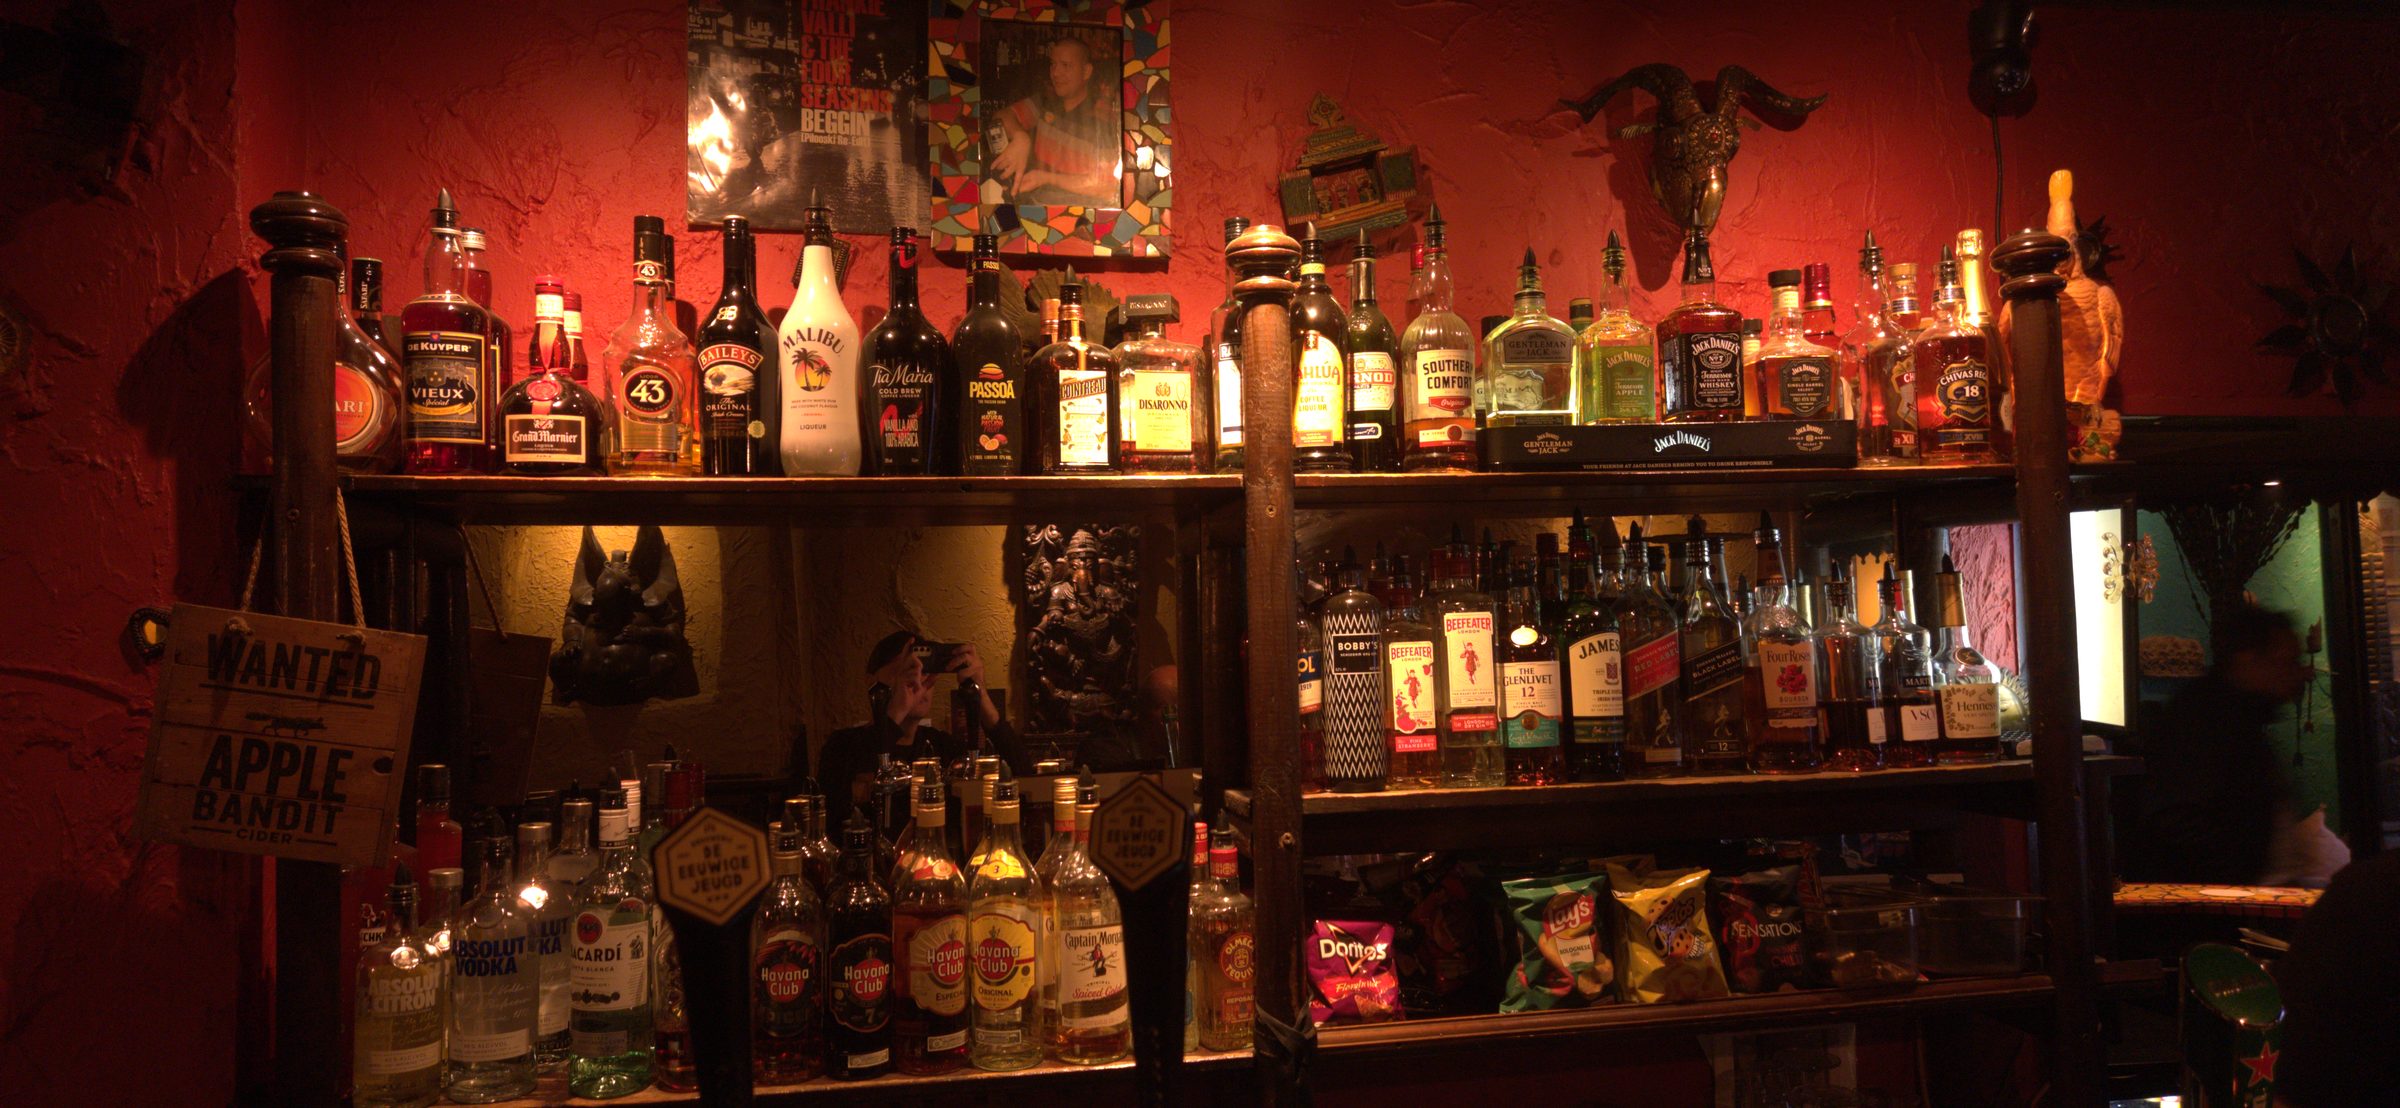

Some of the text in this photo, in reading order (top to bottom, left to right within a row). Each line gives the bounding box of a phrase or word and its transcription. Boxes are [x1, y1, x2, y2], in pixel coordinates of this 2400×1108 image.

[801, 10, 855, 37] VALLI
[801, 34, 854, 62] & THE
[801, 59, 853, 85] FOUR
[640, 265, 656, 277] 43
[407, 341, 469, 353] DE KUYPER
[783, 327, 845, 354] MALIBU
[1508, 340, 1567, 349] GENTLEMAN
[1691, 337, 1740, 356] JACK DANIEL'S
[701, 347, 757, 366] BAILEYS
[1605, 351, 1650, 369] JACK DANIEL'S
[867, 364, 934, 388] Tia Maria
[1297, 361, 1341, 386] AHLÚA
[1354, 372, 1393, 383] RNOD
[1701, 370, 1733, 379] Tennessee
[1791, 365, 1802, 375] JACK
[1940, 369, 1973, 386] CHIVAS
[1061, 378, 1107, 399] COINTREAU
[1427, 375, 1472, 390] COMFORT
[1616, 382, 1644, 390] Tennessee
[1963, 384, 1980, 397] 18
[412, 387, 465, 400] VIEUX
[630, 379, 666, 404] 43
[705, 404, 752, 412] ORIGINAL
[1139, 399, 1187, 410] DISARONNO
[1441, 397, 1465, 408] Original
[512, 430, 578, 443] Grand Marnier
[1523, 440, 1573, 448] GENTLEMAN
[1654, 430, 1712, 453] JACK DANIEL'S
[1537, 447, 1559, 455] JACK
[1446, 617, 1492, 632] BEEFEATER
[1337, 641, 1378, 651] BOBBY'S
[1391, 646, 1432, 660] BEEFEATER
[1579, 638, 1620, 659] JAMES
[1634, 647, 1679, 673] RED LABEL
[1767, 651, 1789, 663] Four
[208, 633, 381, 700] WANTED
[1692, 656, 1741, 678] BLACK LABEL
[1503, 675, 1552, 687] GLENLIVET
[1905, 676, 1930, 687] MART
[1522, 686, 1535, 698] 12
[1957, 702, 1998, 711] Henness
[1718, 742, 1729, 751] 12
[199, 734, 354, 803] APPLE
[192, 789, 344, 835] BANDIT
[236, 828, 293, 845] CIDER
[703, 844, 720, 858] DE
[679, 855, 750, 880] EEUWIGE
[691, 873, 742, 893] JEUGD
[1548, 896, 1591, 935] Lay's
[451, 936, 526, 959] ABSOLUT
[1065, 931, 1123, 950] Captain Morga
[1225, 938, 1254, 955] OLMEC
[570, 943, 622, 962] ACARDÍ
[927, 947, 964, 964] Havan
[1319, 938, 1388, 961] Doritos
[1559, 943, 1591, 955] BOLOGNESE
[455, 956, 518, 977] VODKA
[844, 963, 890, 981] Havana
[938, 960, 963, 977] Club
[980, 958, 1008, 974] Club
[761, 967, 809, 982] Havana
[370, 971, 440, 995] ABSOLUT
[770, 982, 799, 996] Club
[855, 978, 883, 994] Club
[978, 985, 1013, 996] ORIGINAL
[373, 988, 436, 1013] CITRON
[1072, 988, 1103, 999] Spiced
[865, 1008, 876, 1023] 7
